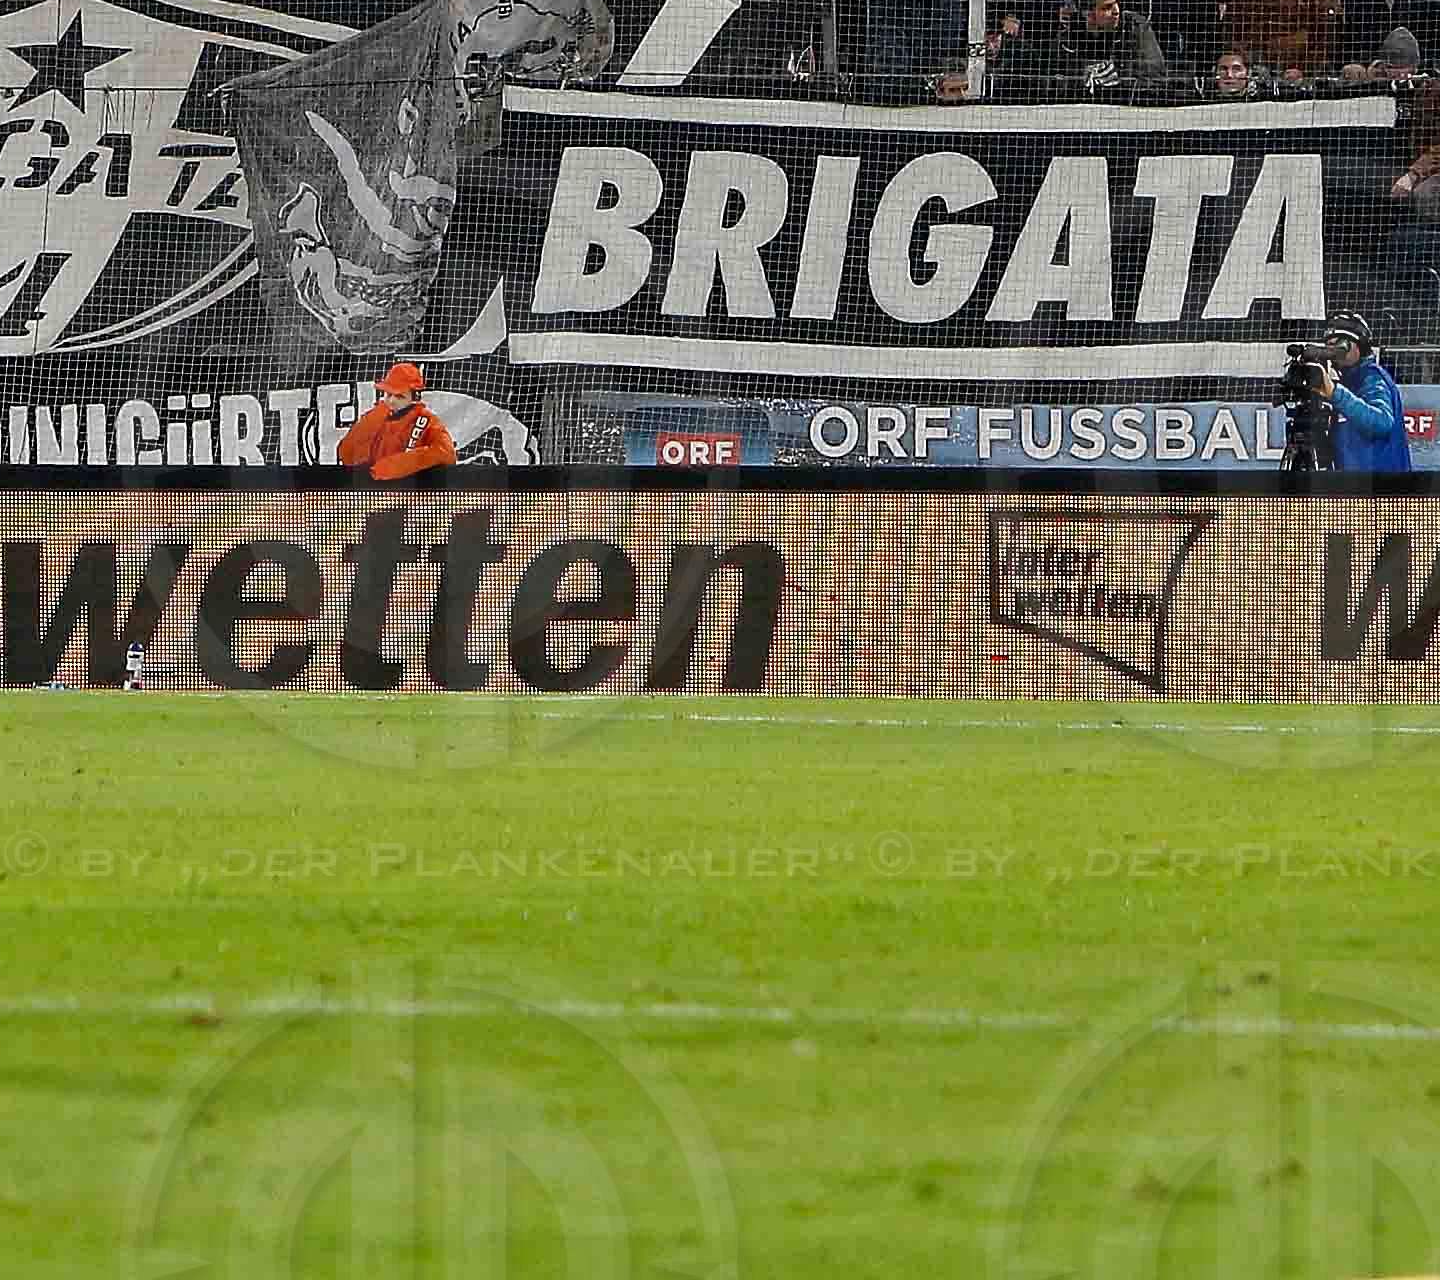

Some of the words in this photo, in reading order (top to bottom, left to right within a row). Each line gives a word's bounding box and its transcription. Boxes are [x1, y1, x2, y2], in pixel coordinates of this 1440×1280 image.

[531, 145, 1324, 325] BRIGATA
[808, 404, 951, 459] ORF
[1404, 414, 1434, 437] RF
[661, 438, 735, 465] ORF
